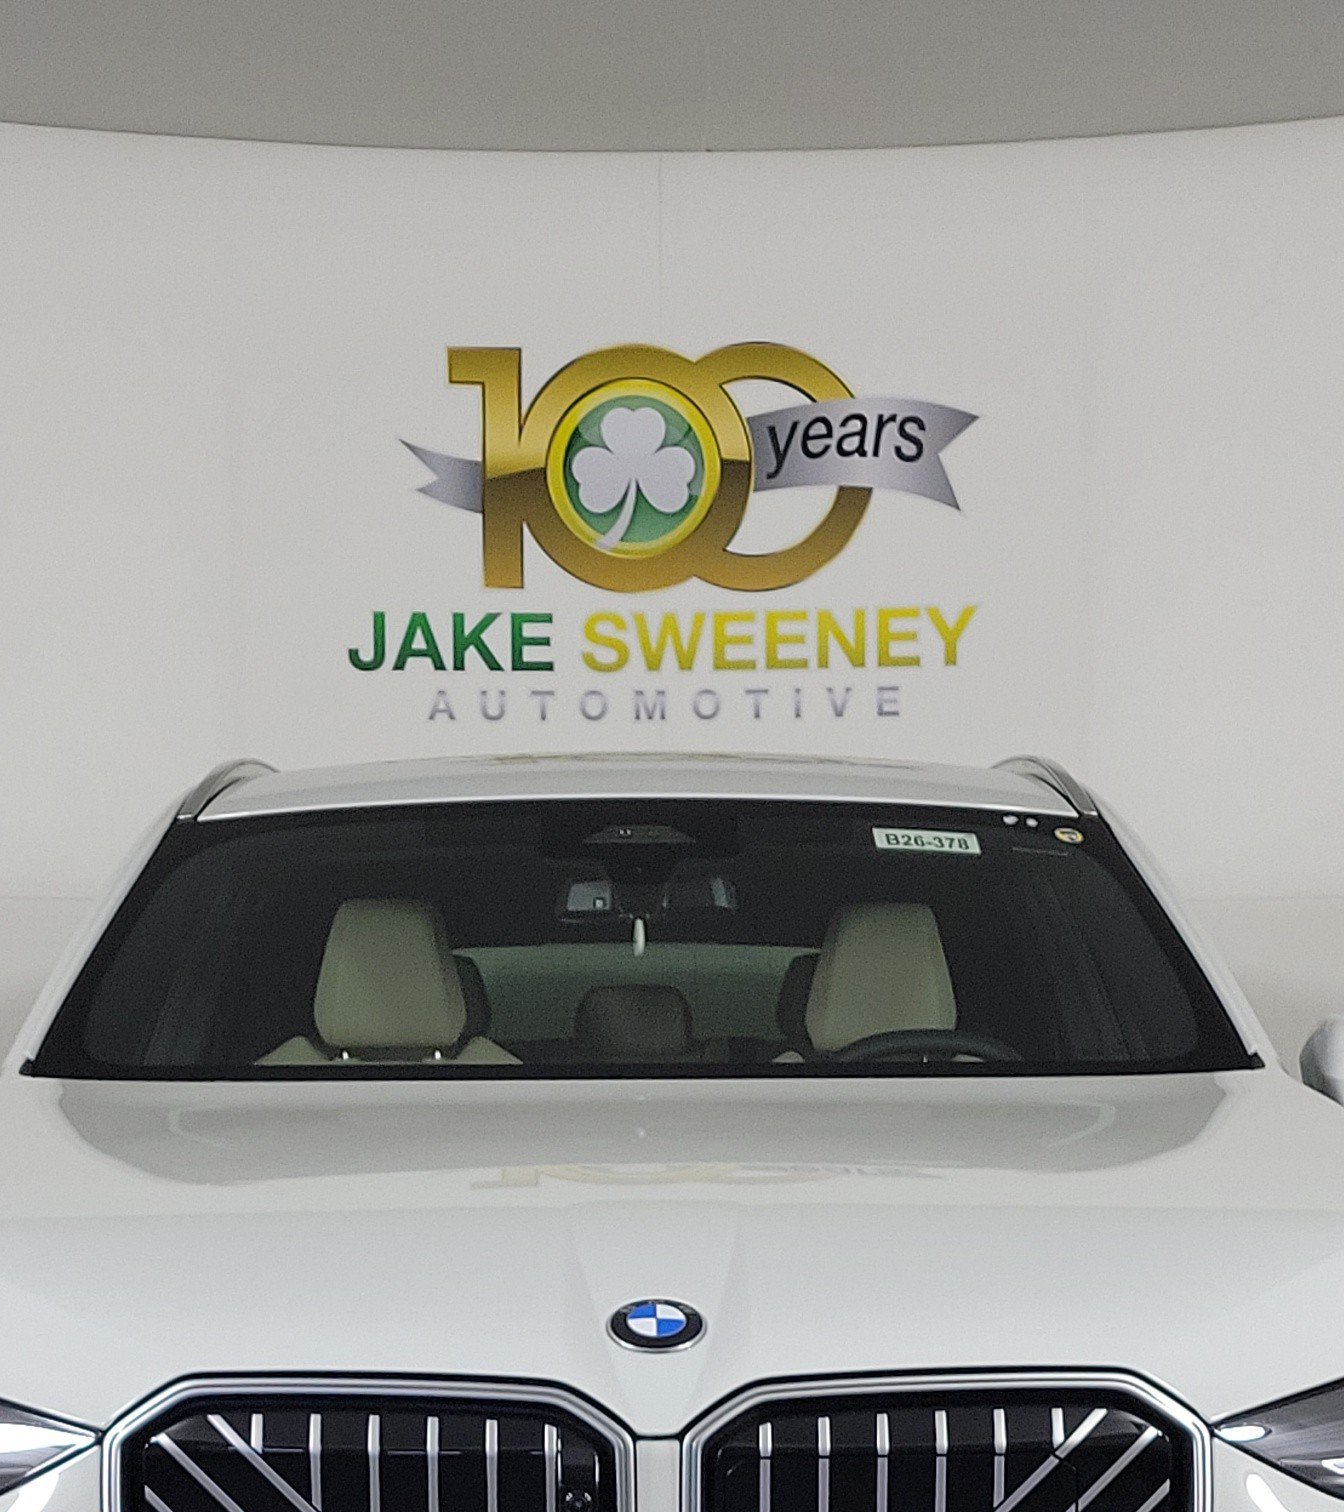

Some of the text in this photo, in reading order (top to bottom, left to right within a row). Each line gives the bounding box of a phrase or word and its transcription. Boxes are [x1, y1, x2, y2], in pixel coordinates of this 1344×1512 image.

[447, 341, 926, 592] 100 years
[347, 604, 977, 673] JAKE SWEENEY
[427, 686, 901, 722] AUTOMOTIVE
